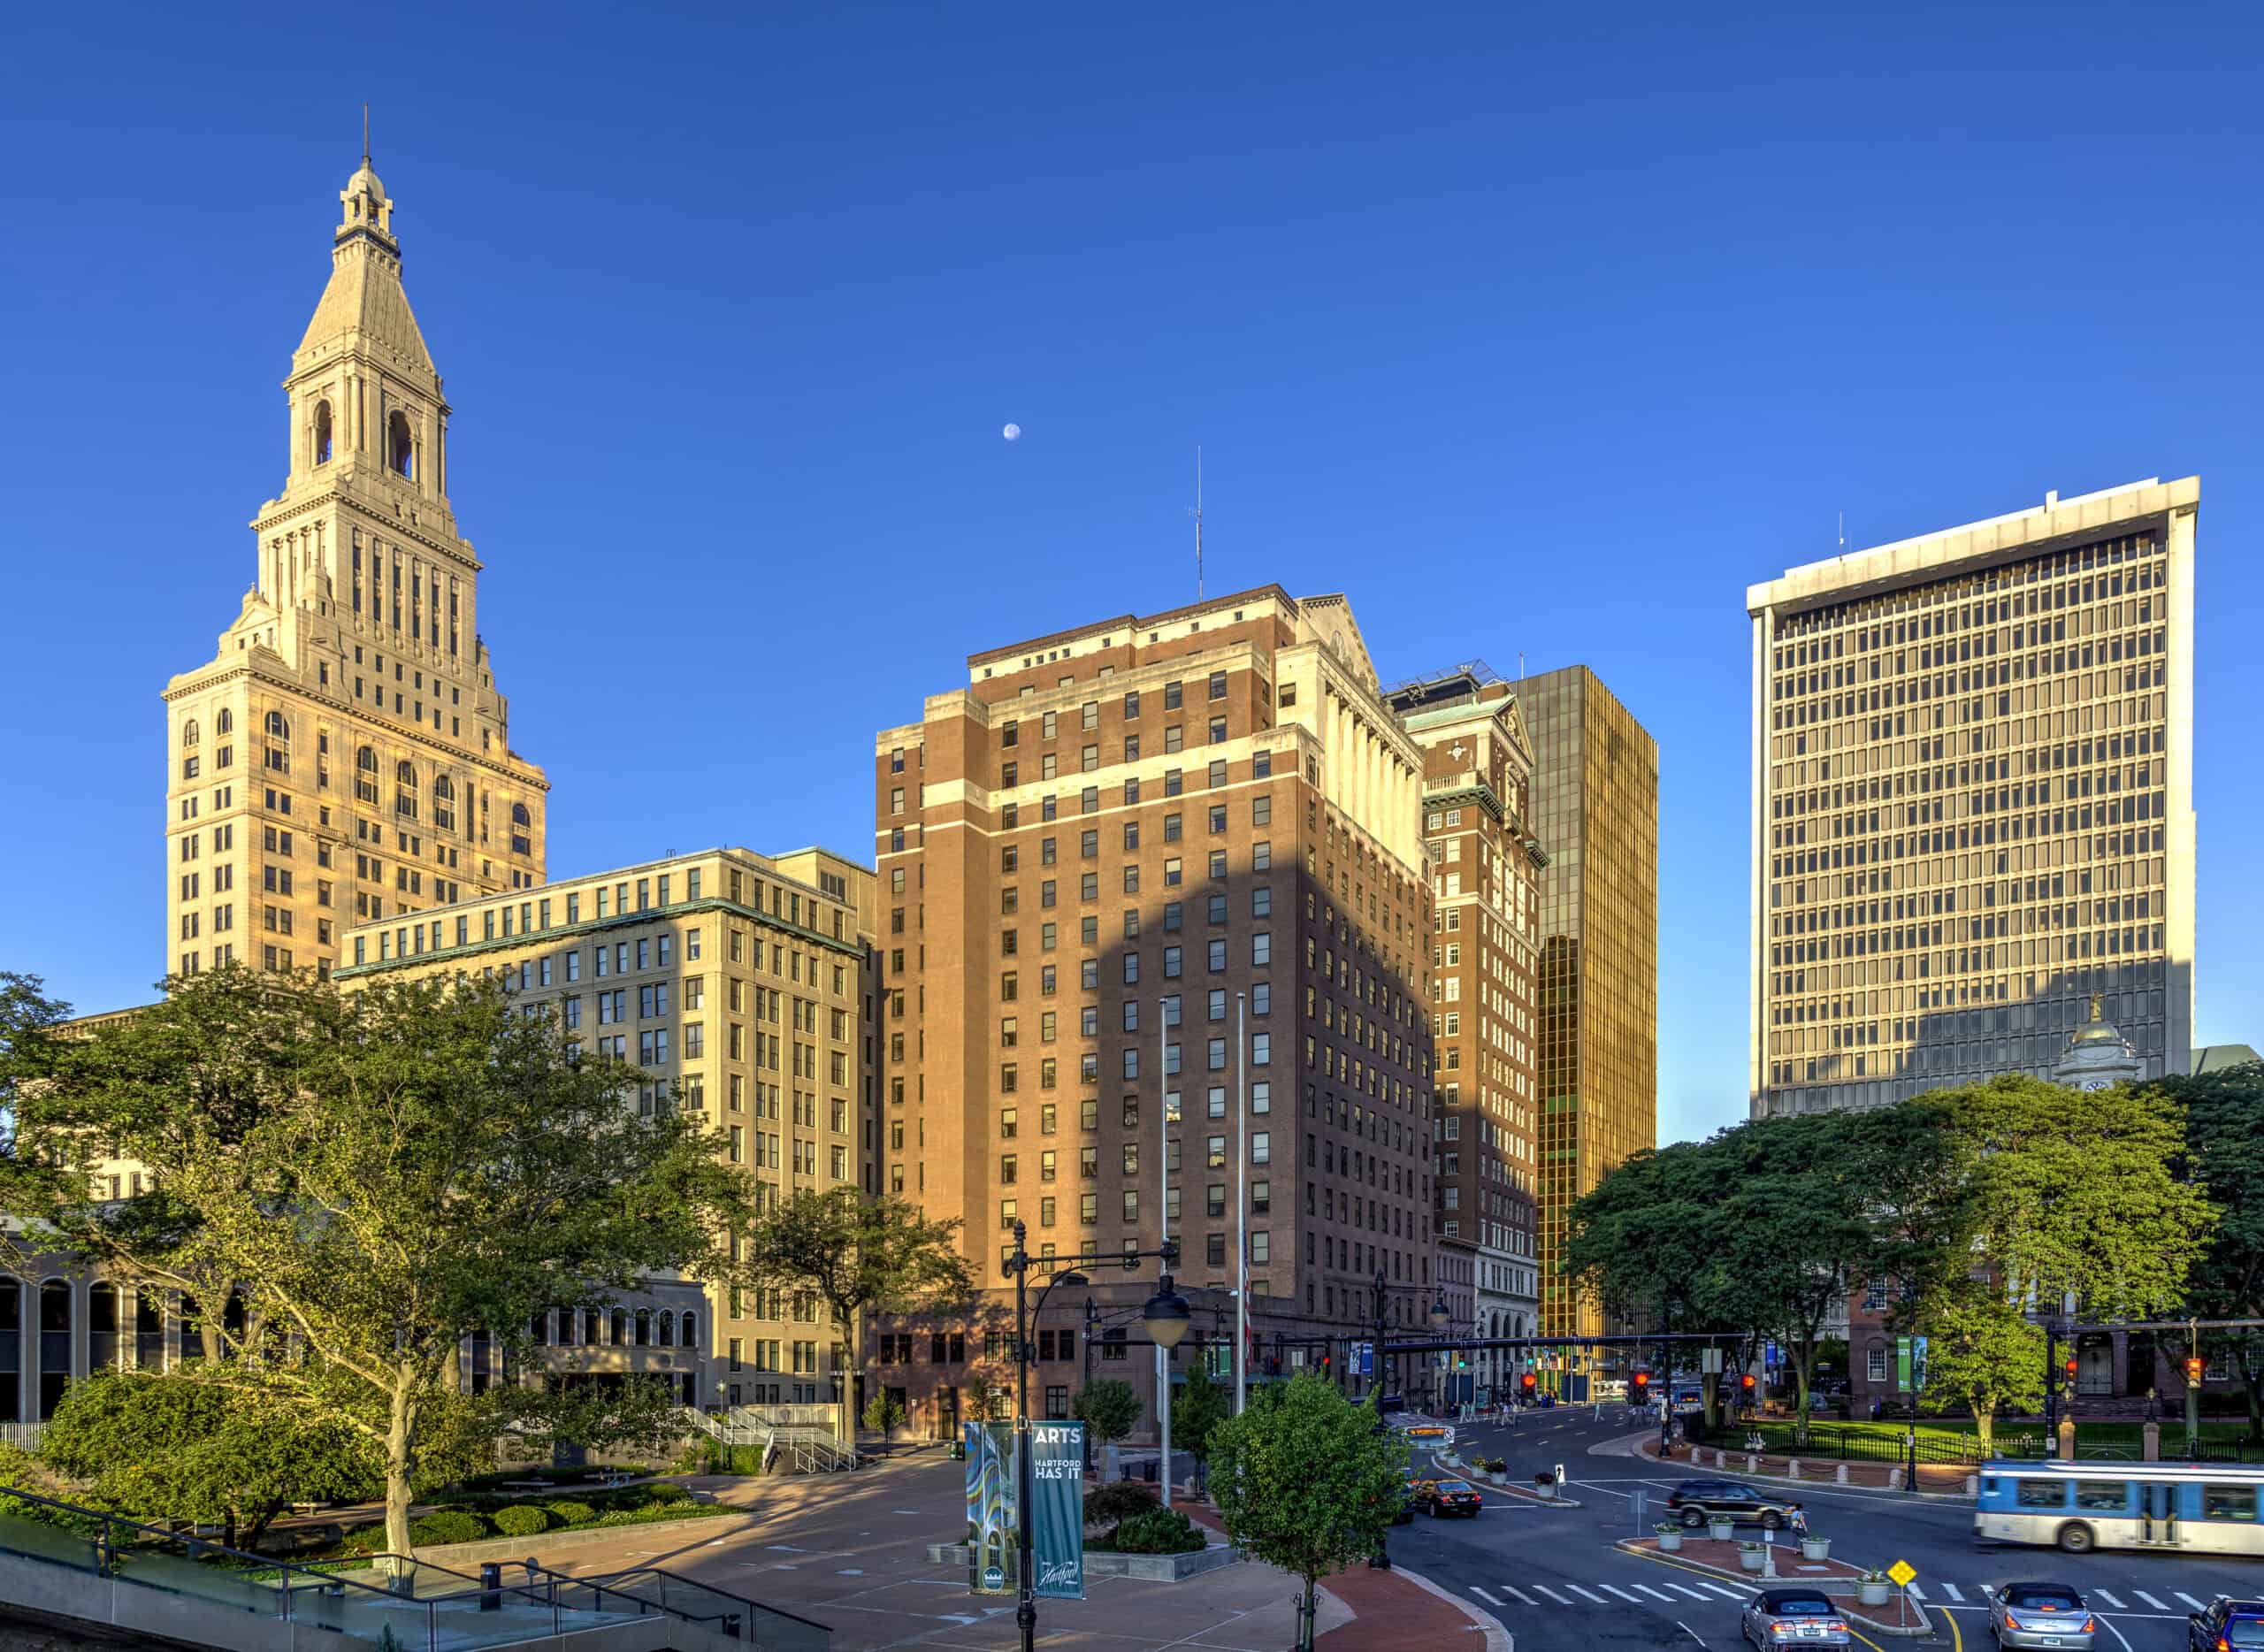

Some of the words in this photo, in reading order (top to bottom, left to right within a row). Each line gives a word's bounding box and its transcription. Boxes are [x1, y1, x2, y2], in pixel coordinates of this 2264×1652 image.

[1035, 1428, 1081, 1443] ARTS
[1035, 1459, 1081, 1468] HARTFORD
[1035, 1467, 1062, 1479] HAS
[1068, 1468, 1081, 1480] IT
